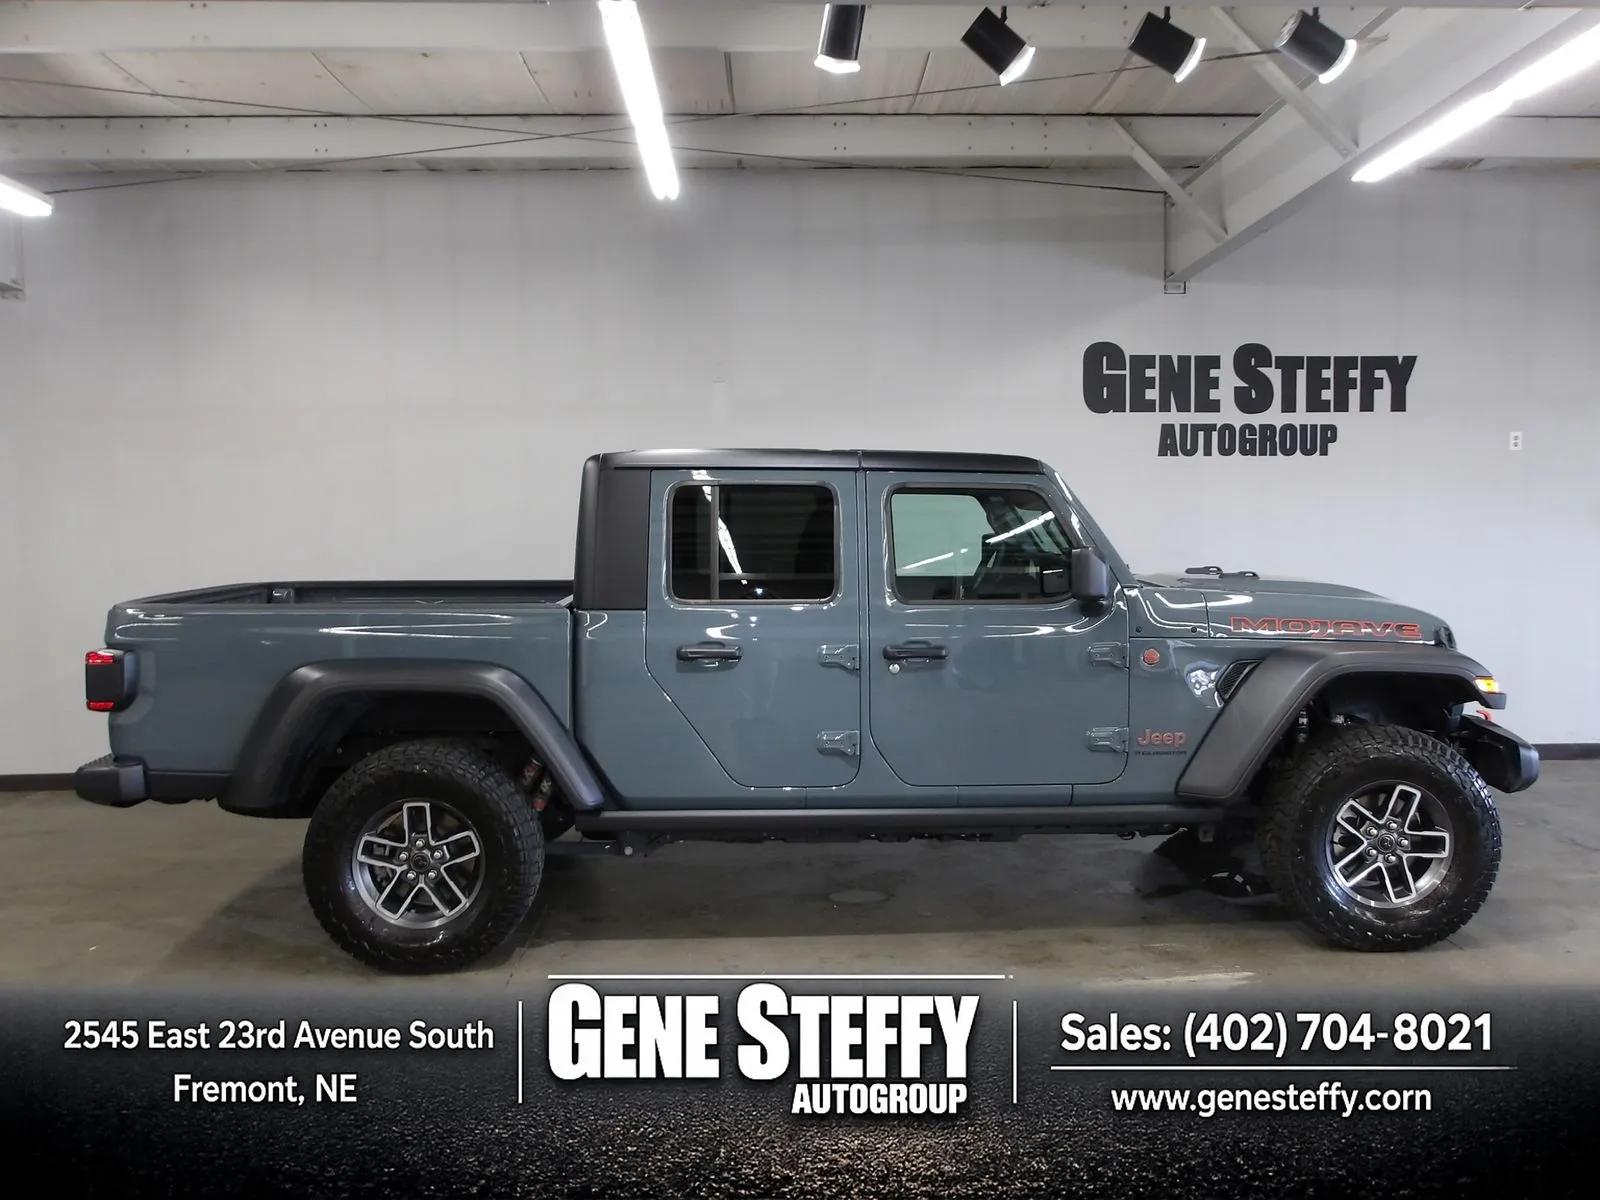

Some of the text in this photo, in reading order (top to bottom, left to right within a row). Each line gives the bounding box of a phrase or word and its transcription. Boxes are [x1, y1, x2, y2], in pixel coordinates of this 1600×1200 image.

[1082, 341, 1418, 415] GENE STEFFY
[1157, 423, 1338, 457] AUTOGROUP
[1230, 616, 1422, 639] MOJAVE
[1136, 727, 1187, 748] Jeep
